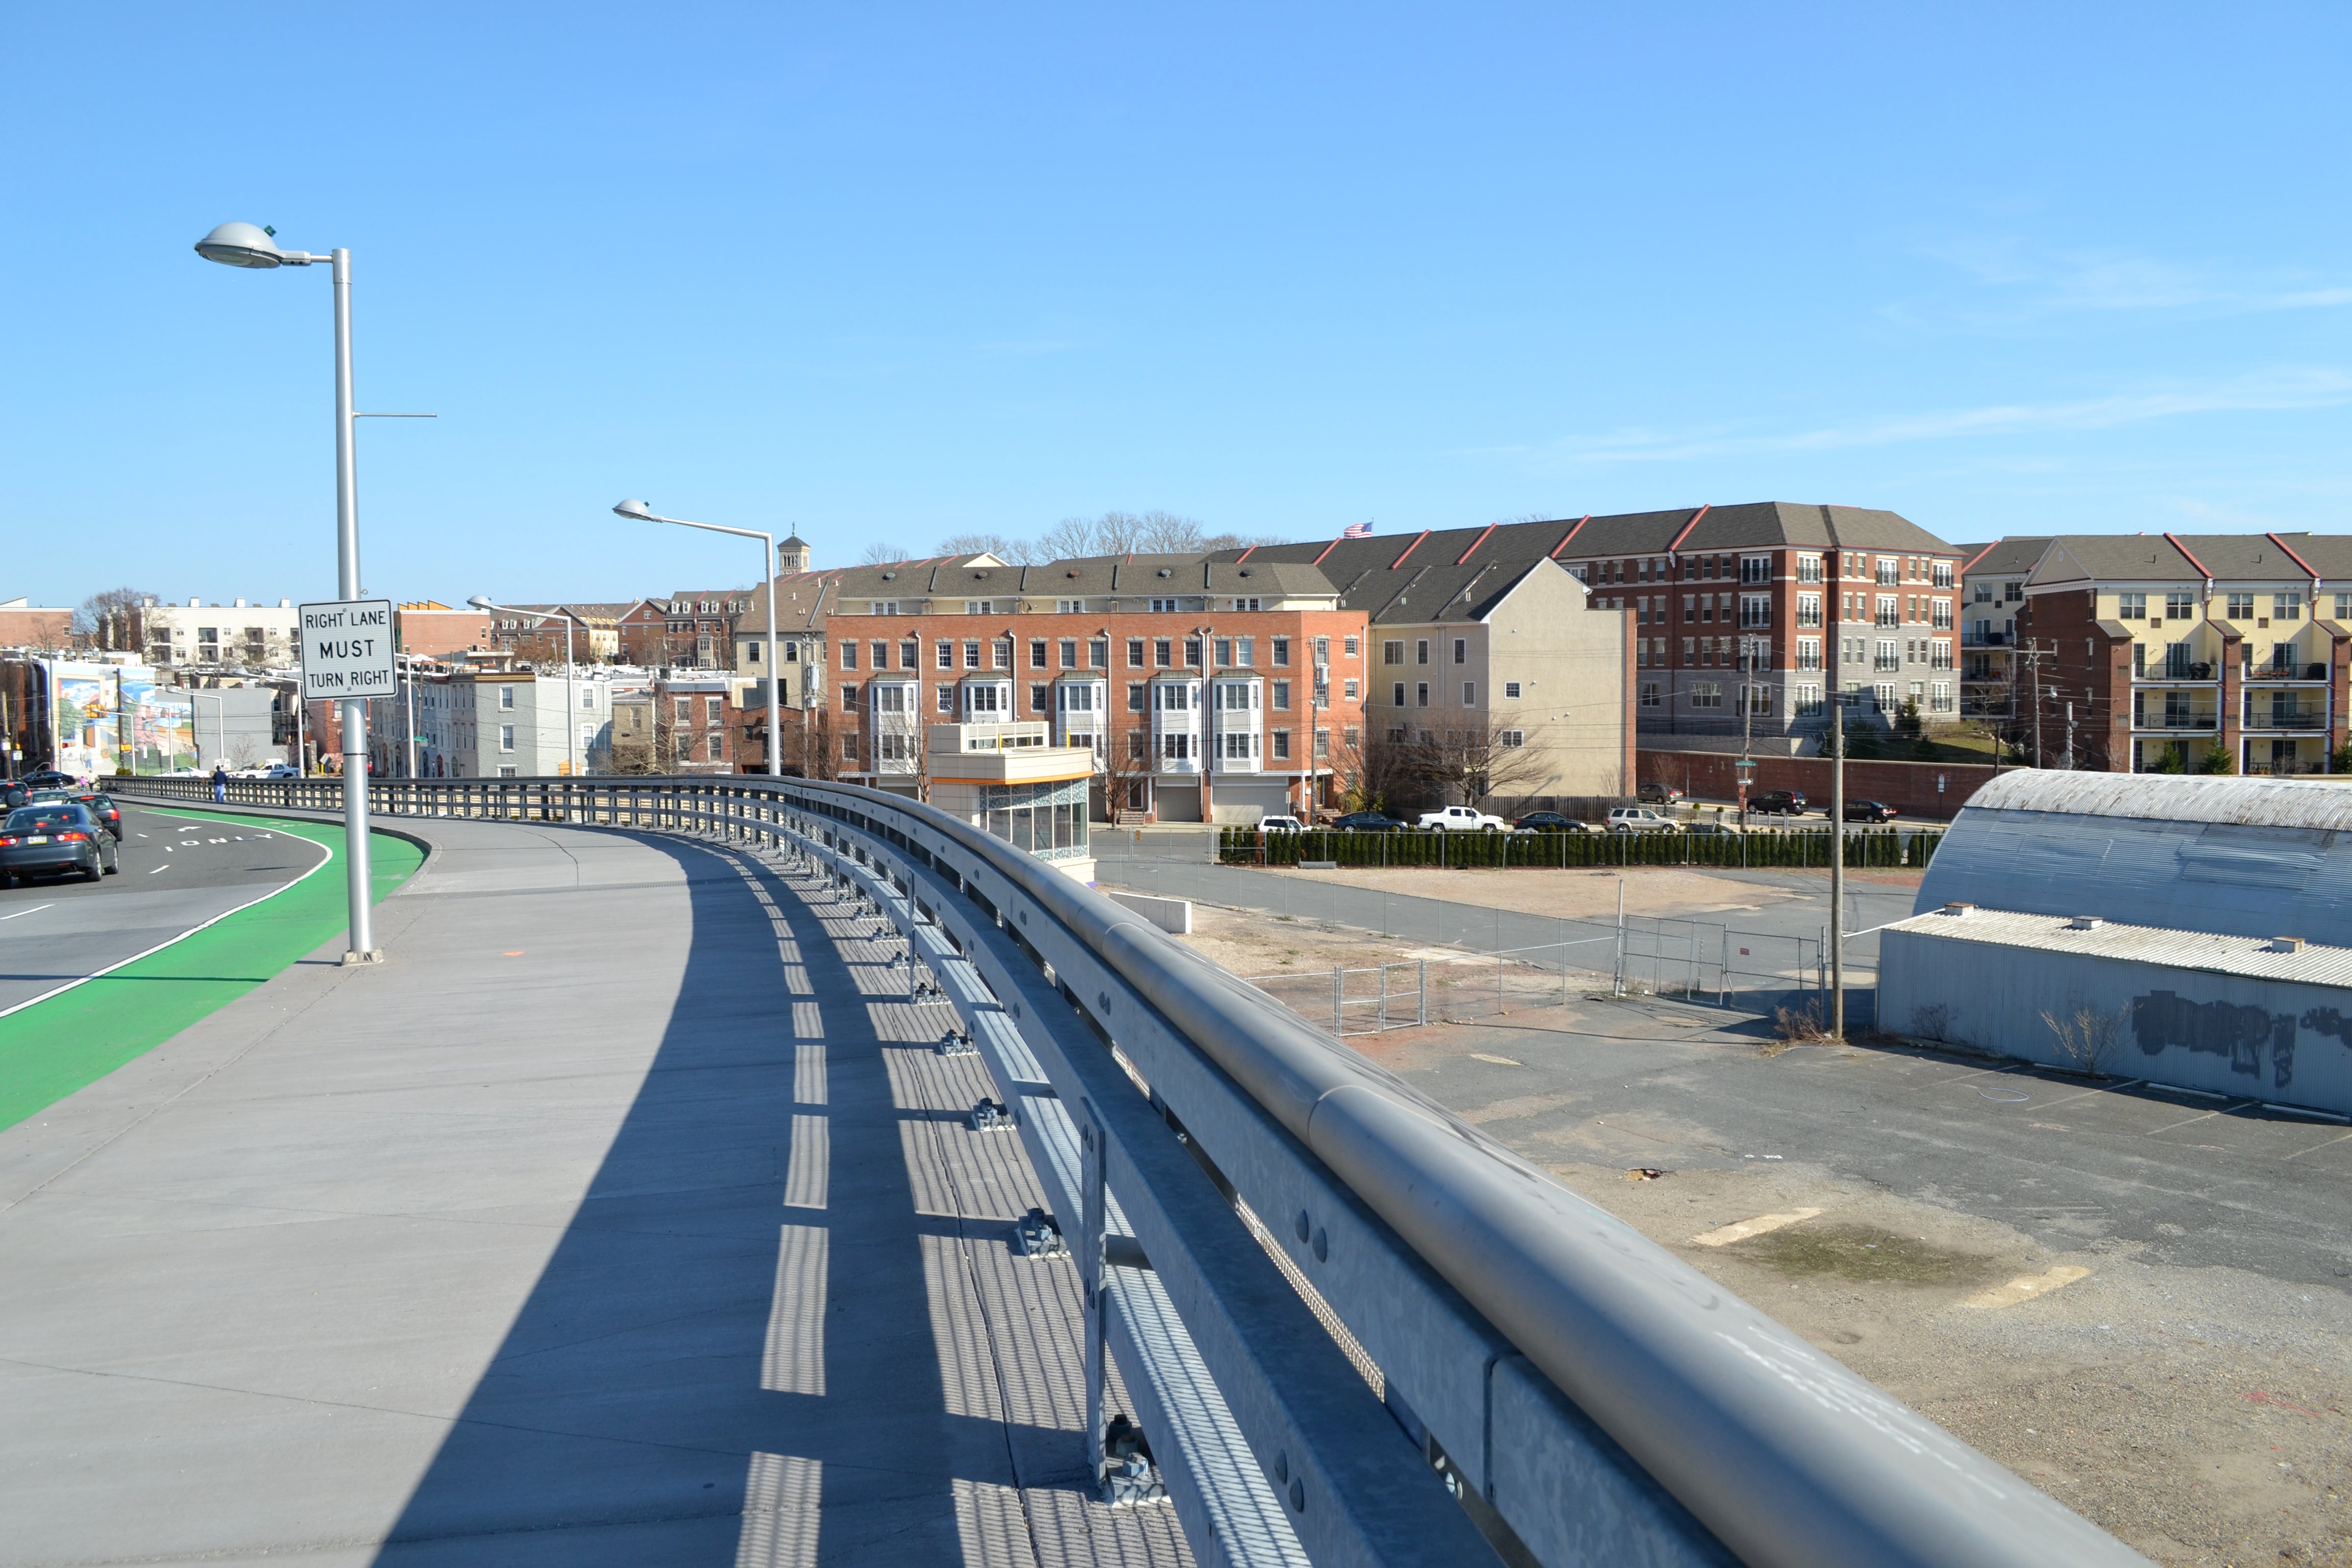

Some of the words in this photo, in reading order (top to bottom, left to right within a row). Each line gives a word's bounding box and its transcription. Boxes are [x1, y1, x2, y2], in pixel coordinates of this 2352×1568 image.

[306, 613, 344, 628] RIGHT
[351, 610, 386, 626] LANE
[320, 640, 375, 659] MUST
[309, 672, 344, 688] TURN
[351, 670, 388, 685] RIGHT
[181, 834, 273, 846] ONLY
